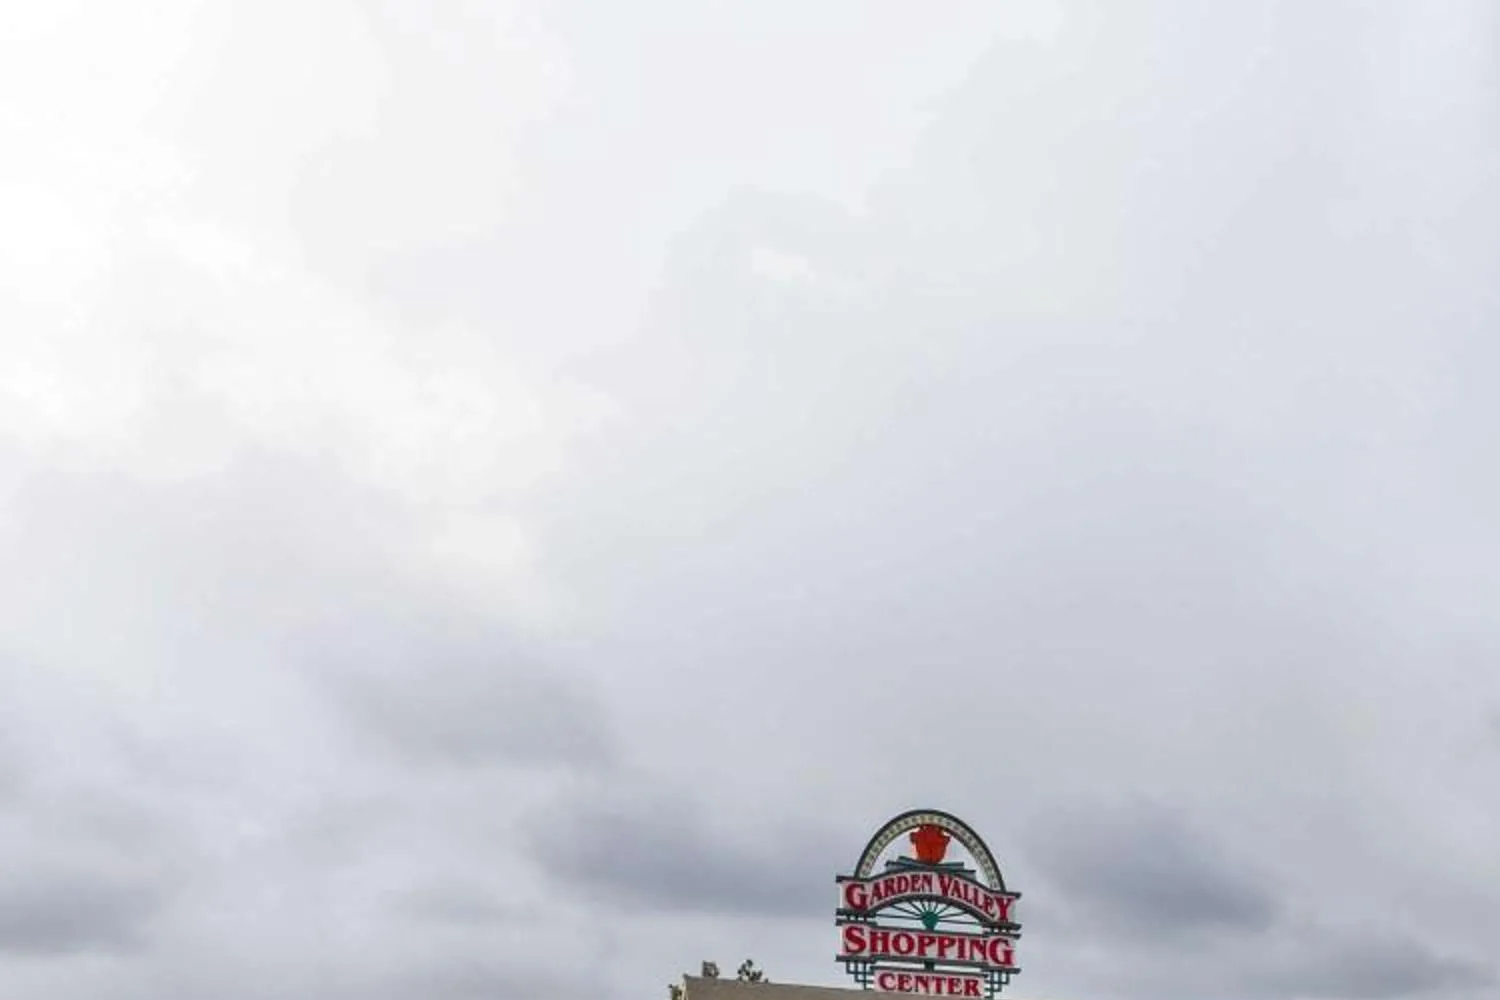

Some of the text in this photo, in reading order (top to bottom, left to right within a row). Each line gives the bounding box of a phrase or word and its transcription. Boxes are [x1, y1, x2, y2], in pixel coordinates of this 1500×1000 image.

[845, 873, 1016, 923] GARDEN VALLEY
[844, 925, 1014, 966] SHOPPING
[878, 972, 982, 997] CENTER
